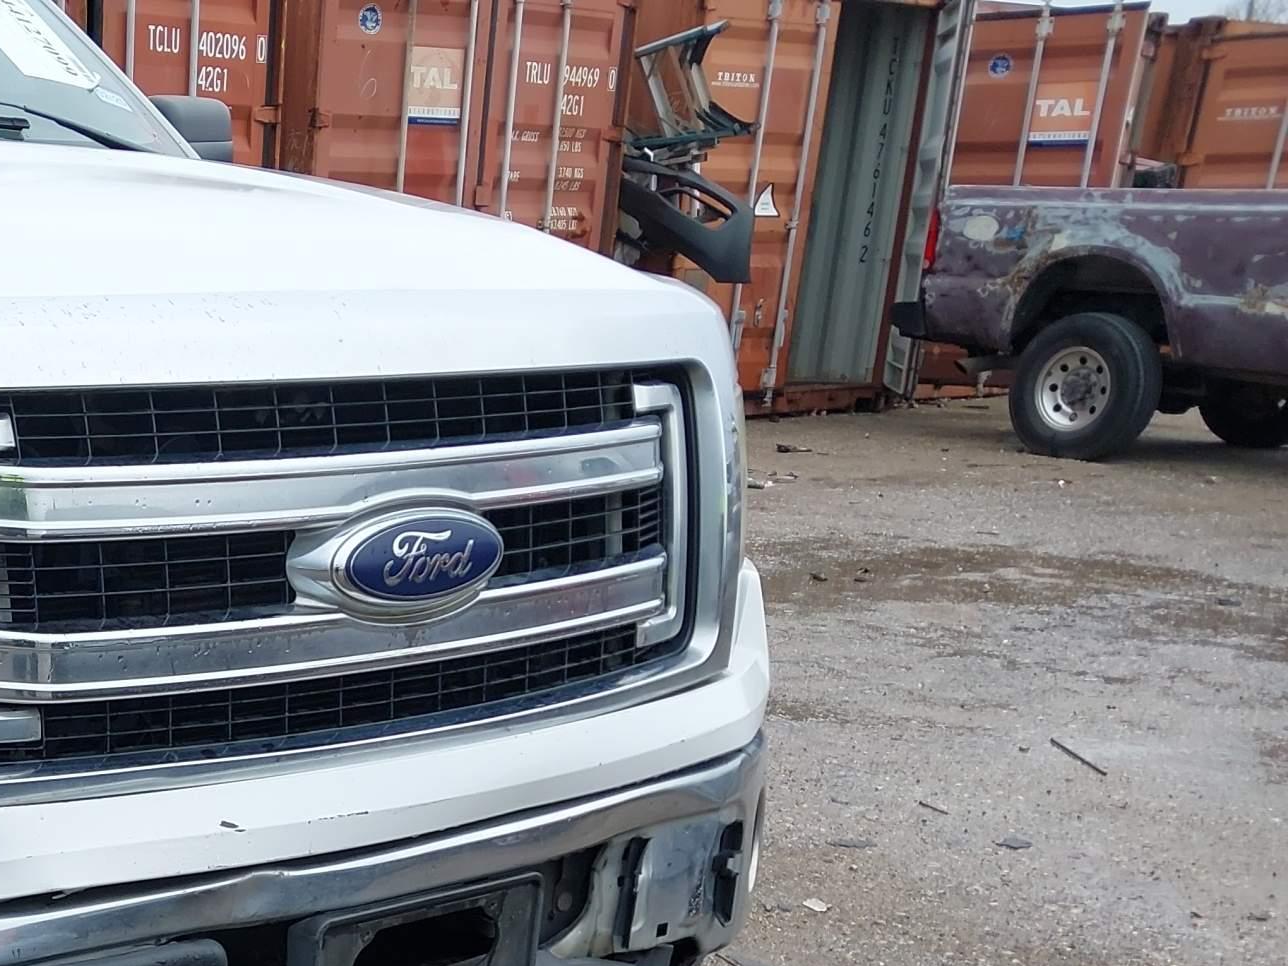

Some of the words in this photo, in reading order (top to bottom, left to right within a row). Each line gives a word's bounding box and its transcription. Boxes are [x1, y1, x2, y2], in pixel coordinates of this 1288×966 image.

[148, 24, 181, 54] TCLU
[199, 31, 247, 60] 402096
[256, 36, 267, 61] 0
[198, 65, 228, 92] 42G1
[410, 64, 458, 89] TAL
[525, 61, 551, 85] TRLU
[563, 65, 600, 88] 944969
[608, 69, 616, 89] 0
[717, 71, 756, 83] TRITON
[1035, 98, 1091, 117] TAL
[383, 529, 475, 588] Ford
